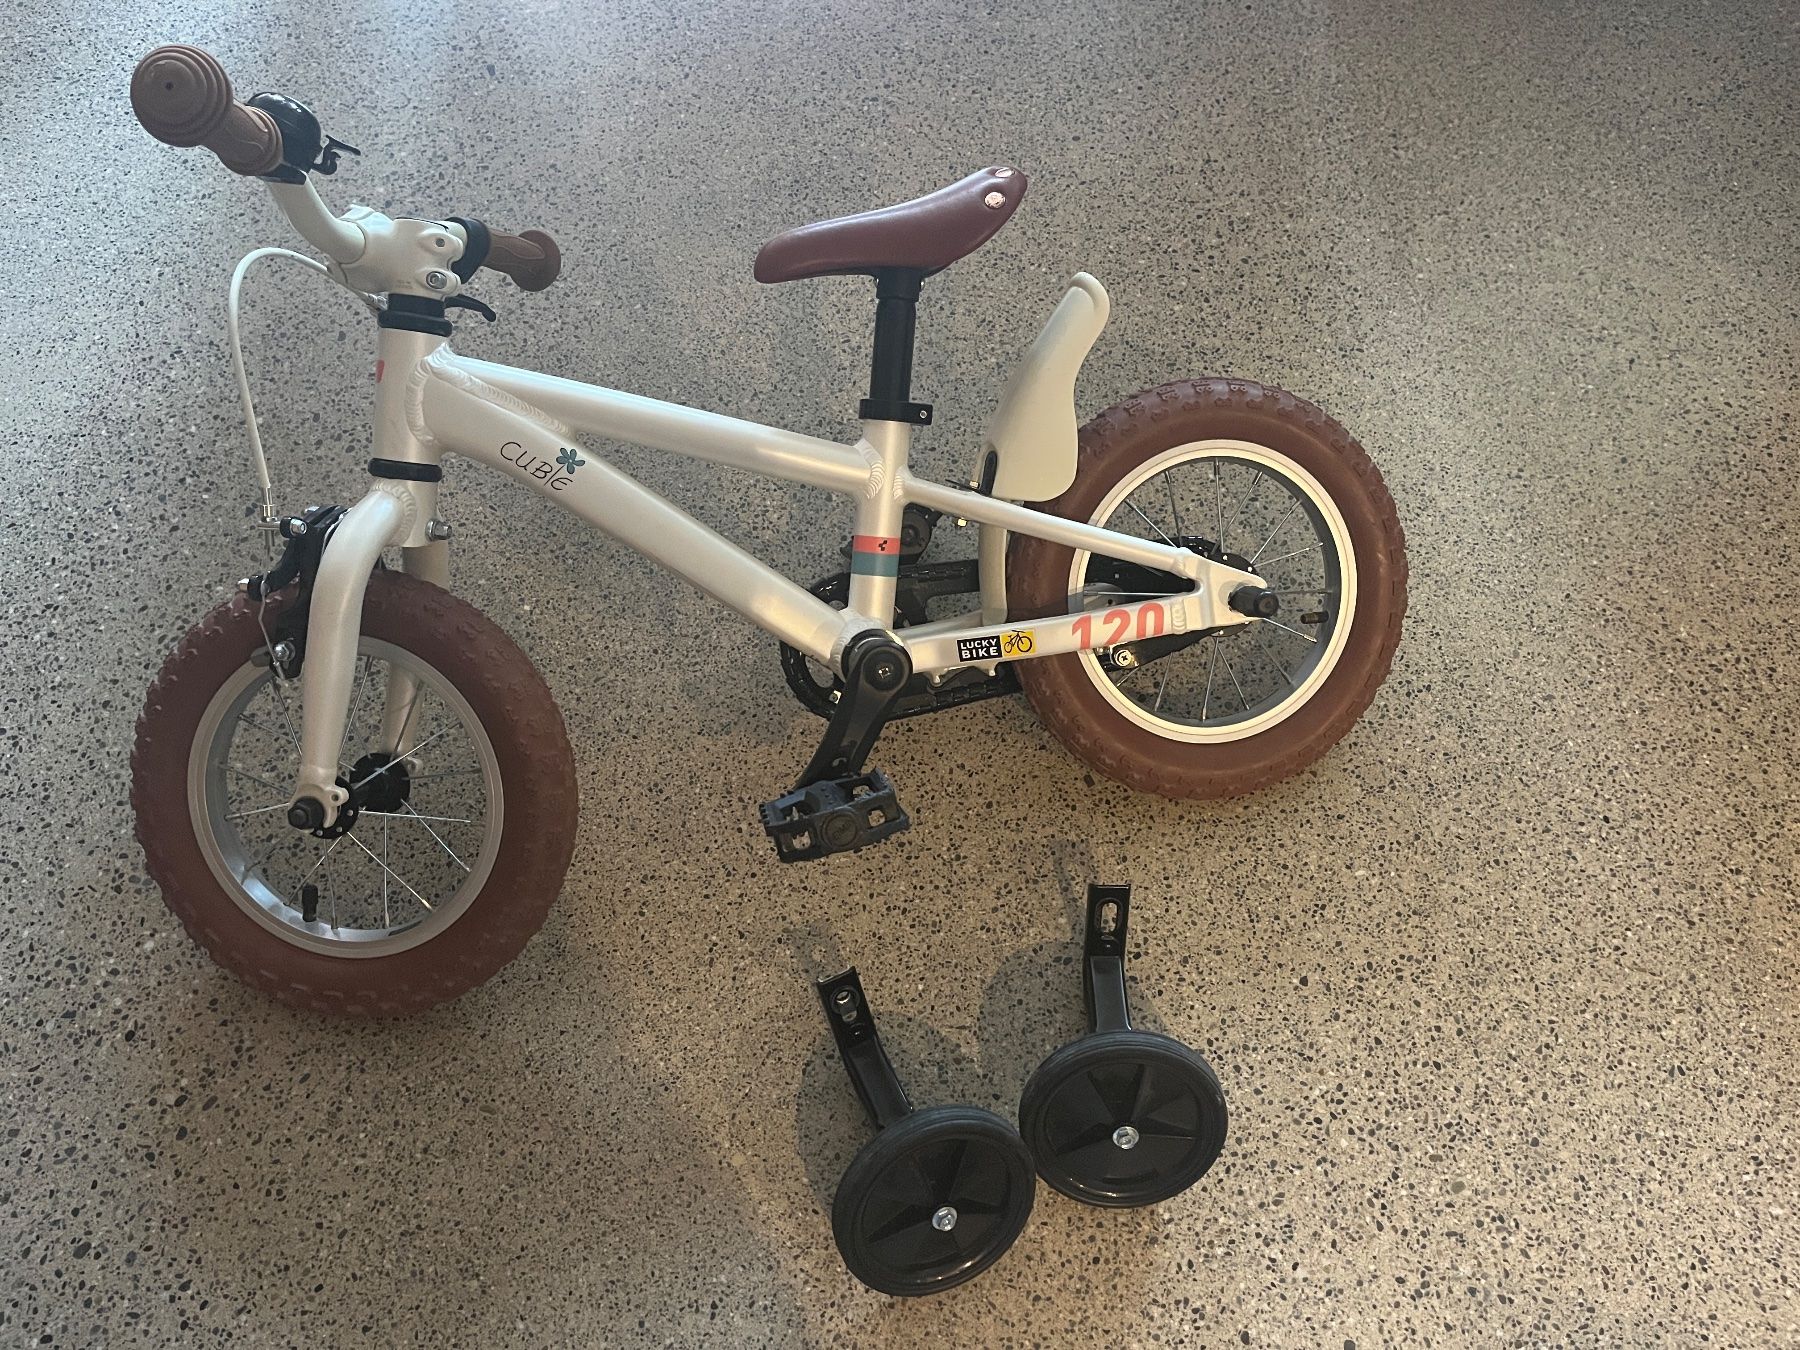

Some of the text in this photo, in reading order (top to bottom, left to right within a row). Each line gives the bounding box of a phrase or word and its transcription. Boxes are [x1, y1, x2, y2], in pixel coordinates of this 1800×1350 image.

[1072, 602, 1164, 650] 120
[960, 638, 997, 650] LUCKY
[961, 646, 999, 659] BIKE
